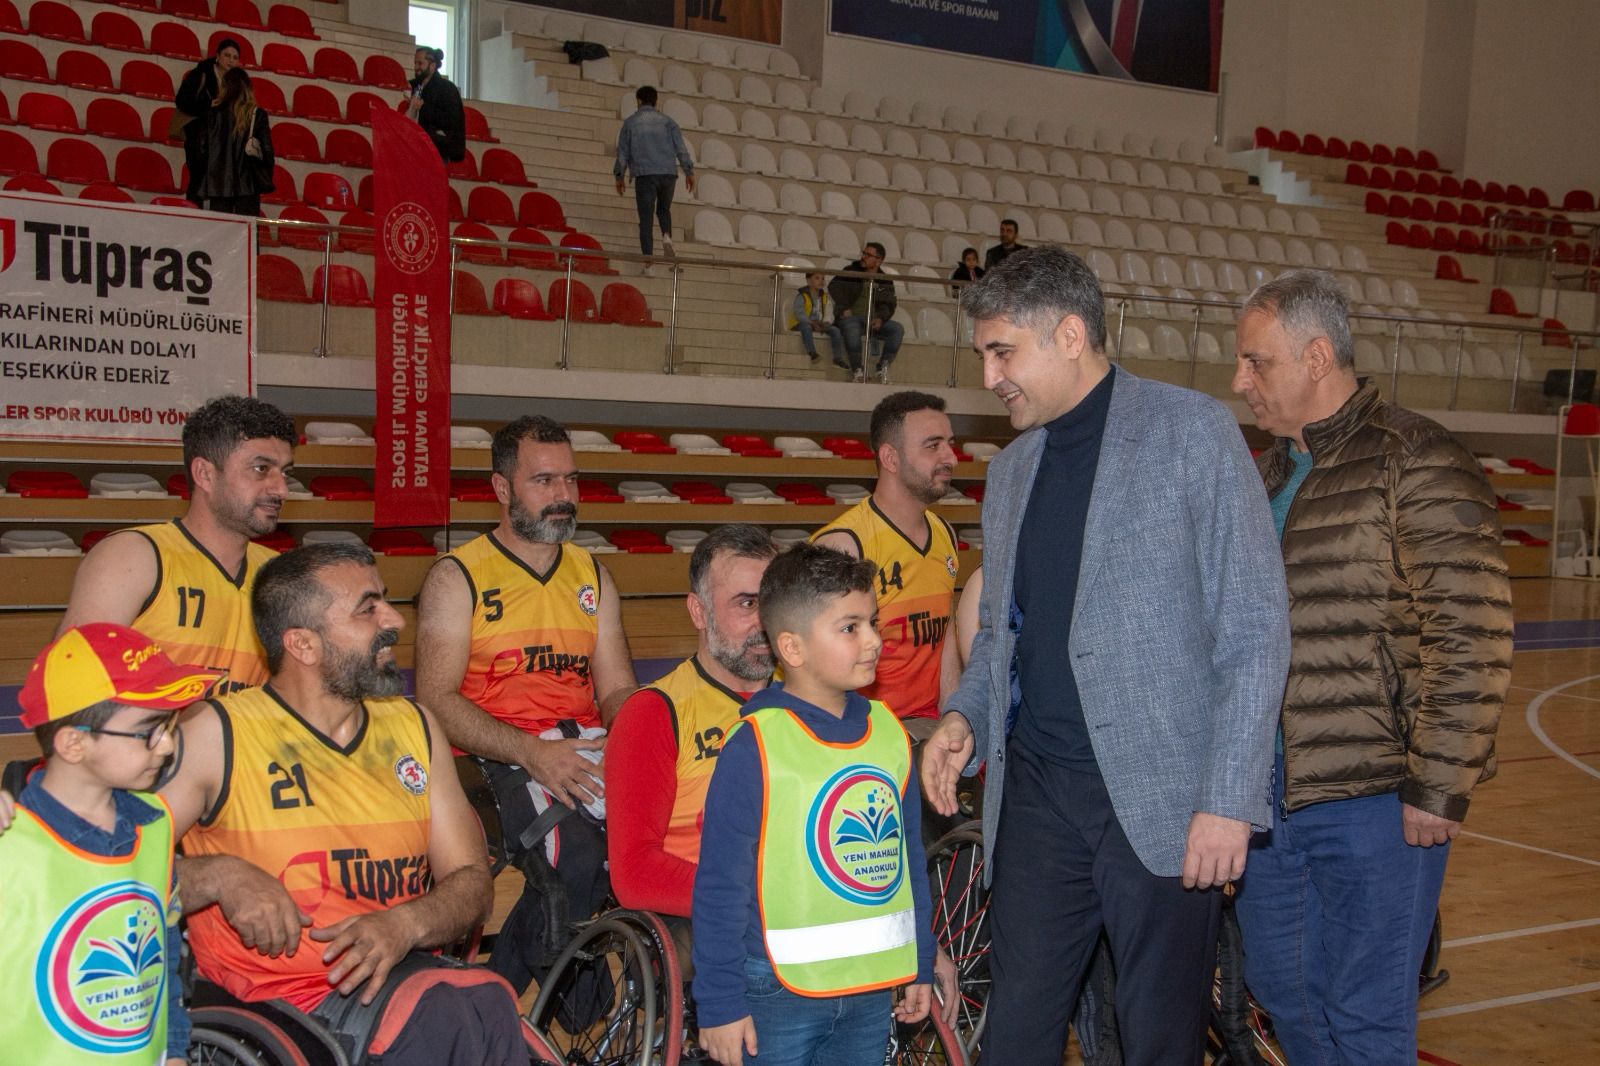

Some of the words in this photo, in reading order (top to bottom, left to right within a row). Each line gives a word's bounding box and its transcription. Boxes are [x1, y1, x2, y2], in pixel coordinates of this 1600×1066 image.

[890, 0, 927, 8] ÇLİK
[929, 0, 940, 11] VE
[941, 2, 964, 15] SPOR
[966, 6, 999, 21] BAKANI
[24, 220, 213, 306] Tüpraş
[0, 302, 94, 325] RAFİNERİ
[100, 307, 243, 335] MÜDÜRLÜĞÜNE
[130, 340, 196, 359] DOLAYI
[0, 361, 97, 382] EŞEKKÜR
[104, 366, 170, 385] EDERİZ
[34, 406, 80, 422] SPOR
[85, 407, 153, 424] KULÜBÜ
[156, 408, 192, 425] YÖN
[879, 561, 903, 595] 14
[178, 586, 206, 628] 17
[482, 588, 504, 622] 5
[694, 727, 724, 760] 12
[268, 762, 315, 810] 21
[843, 851, 867, 863] YENİ
[869, 848, 898, 859] MAHALLE
[855, 862, 897, 875] ANAOKULU
[331, 847, 426, 907] Tüpra
[86, 989, 118, 1004] YENİ
